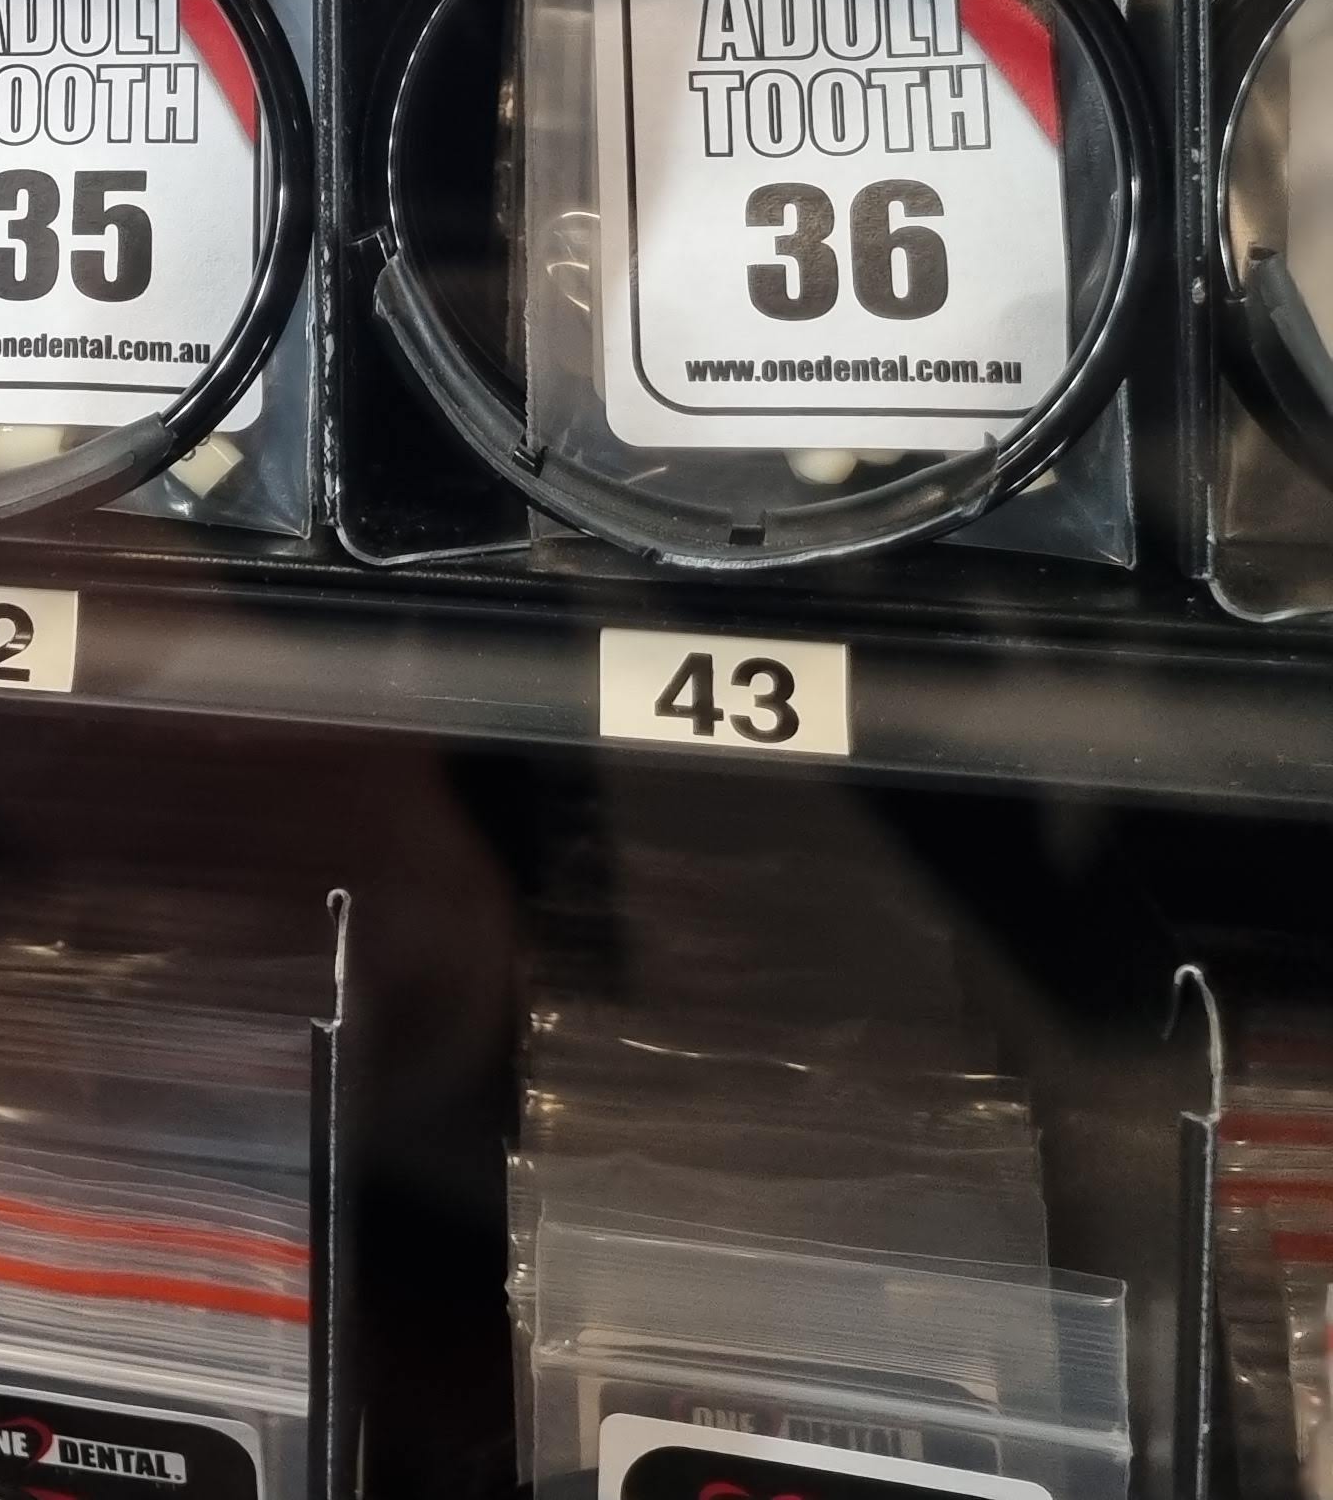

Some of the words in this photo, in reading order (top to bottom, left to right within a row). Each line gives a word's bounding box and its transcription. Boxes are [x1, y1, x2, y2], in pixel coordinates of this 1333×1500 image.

[688, 64, 991, 158] TOOTH
[745, 179, 949, 322] 36
[685, 355, 1022, 385] www.onedental.com.au
[653, 651, 801, 744] 43
